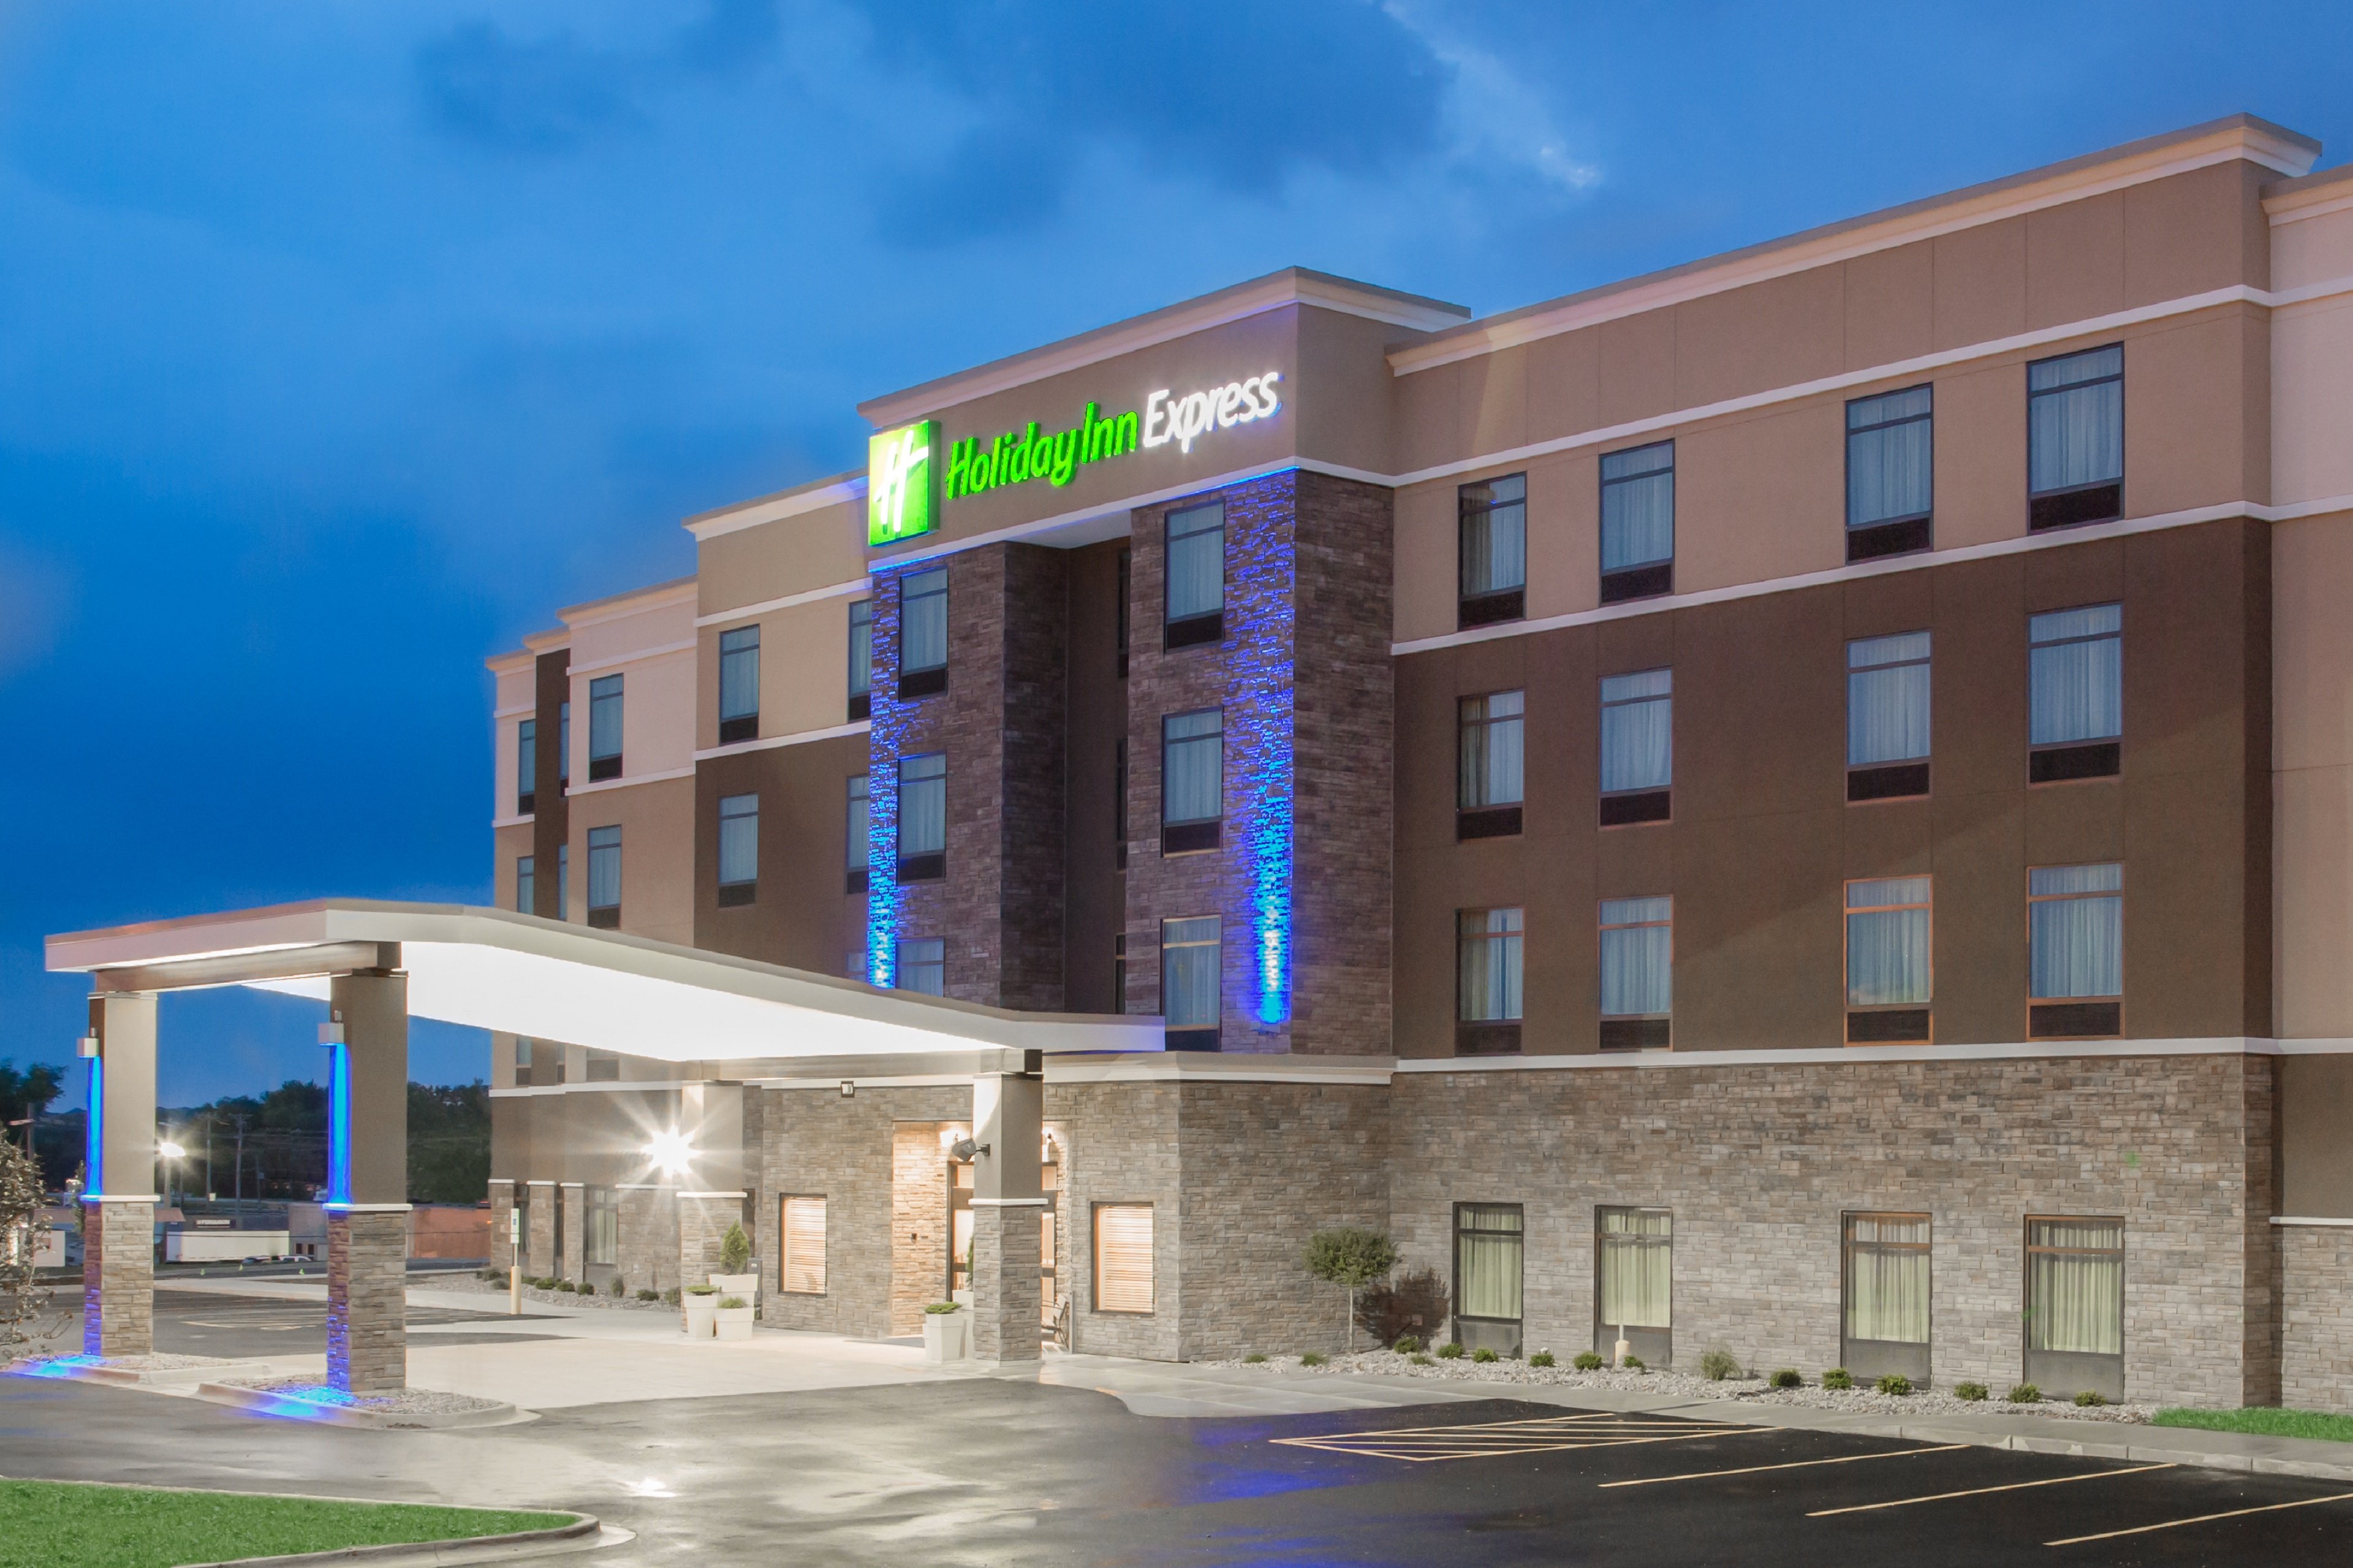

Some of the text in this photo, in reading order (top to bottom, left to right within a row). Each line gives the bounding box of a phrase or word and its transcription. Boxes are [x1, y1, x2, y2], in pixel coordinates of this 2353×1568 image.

[945, 372, 1279, 500] Holiday Inn Express
